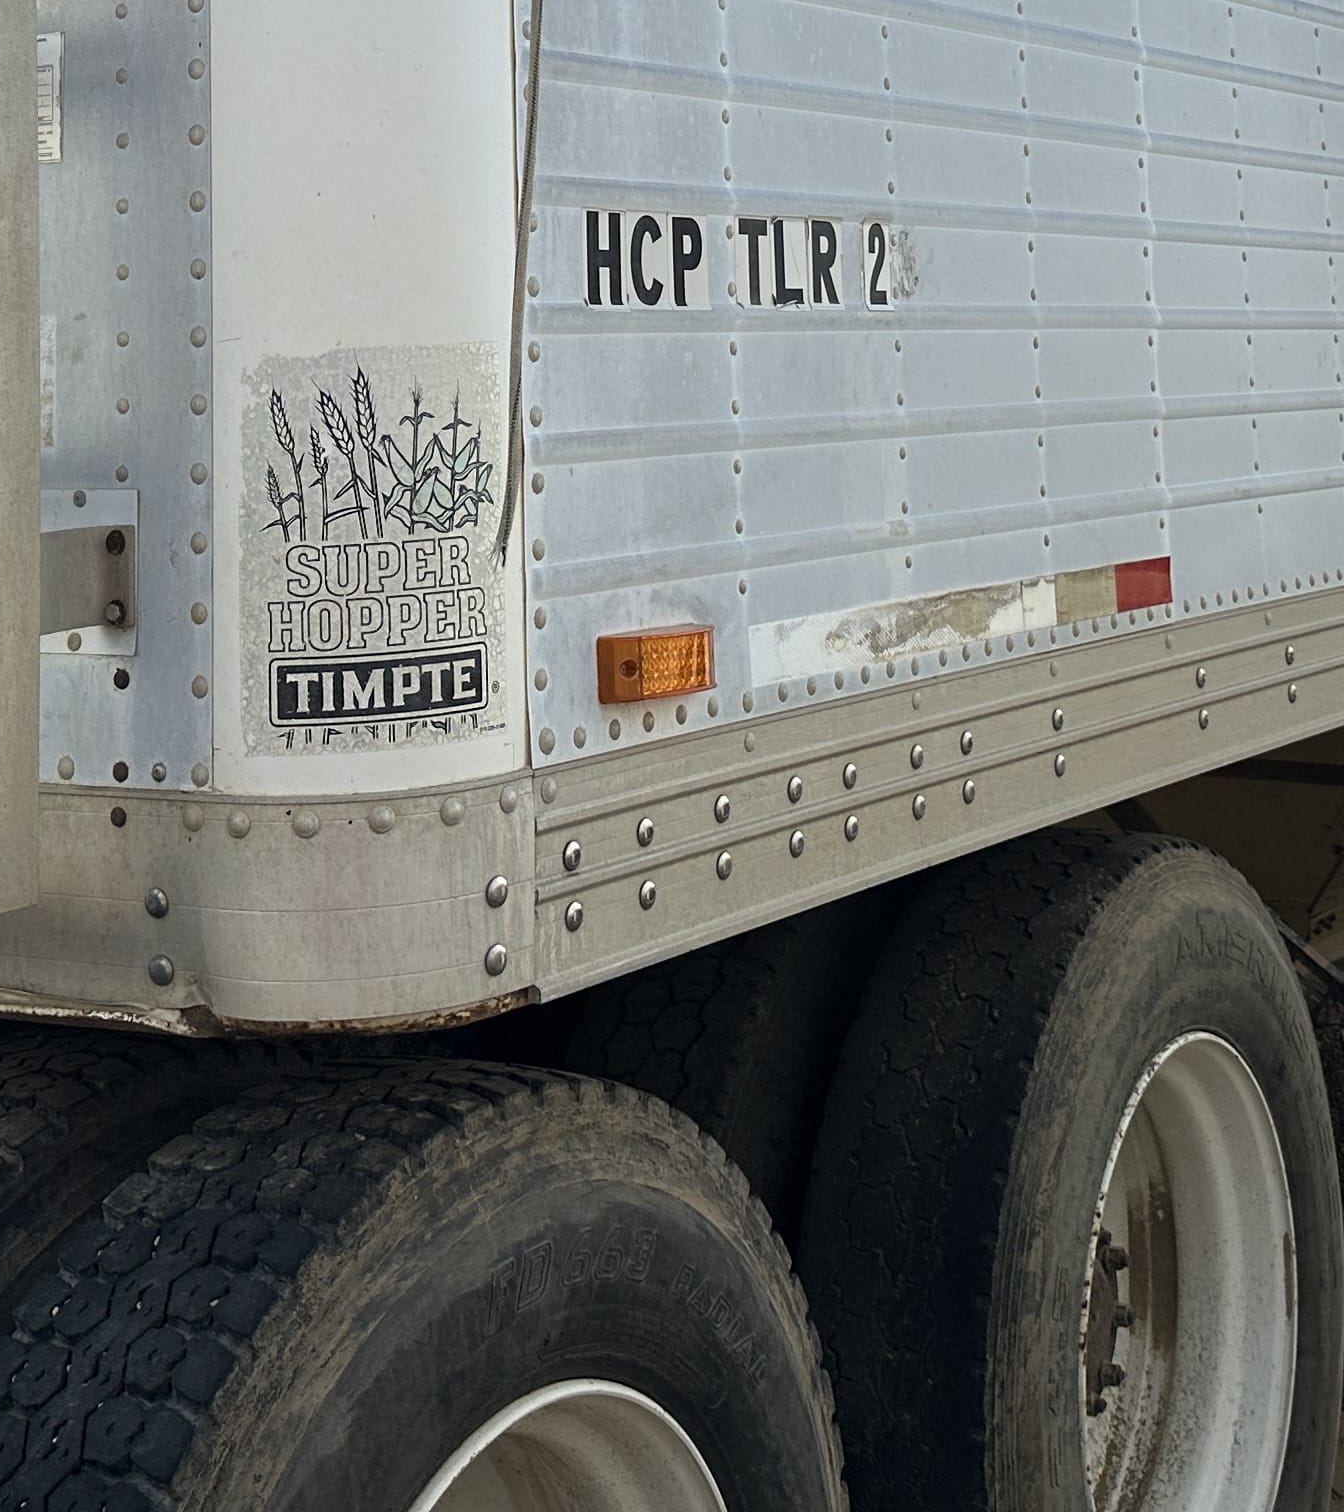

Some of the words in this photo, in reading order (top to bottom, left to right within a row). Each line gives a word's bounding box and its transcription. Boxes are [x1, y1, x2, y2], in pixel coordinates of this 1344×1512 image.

[586, 210, 703, 307] HCP
[738, 217, 841, 306] TLR
[868, 223, 888, 305] 2
[286, 536, 471, 597] SUPER
[268, 587, 487, 652] HOPPER
[286, 658, 476, 713] TIMPTE
[669, 1262, 770, 1386] RADIAL
